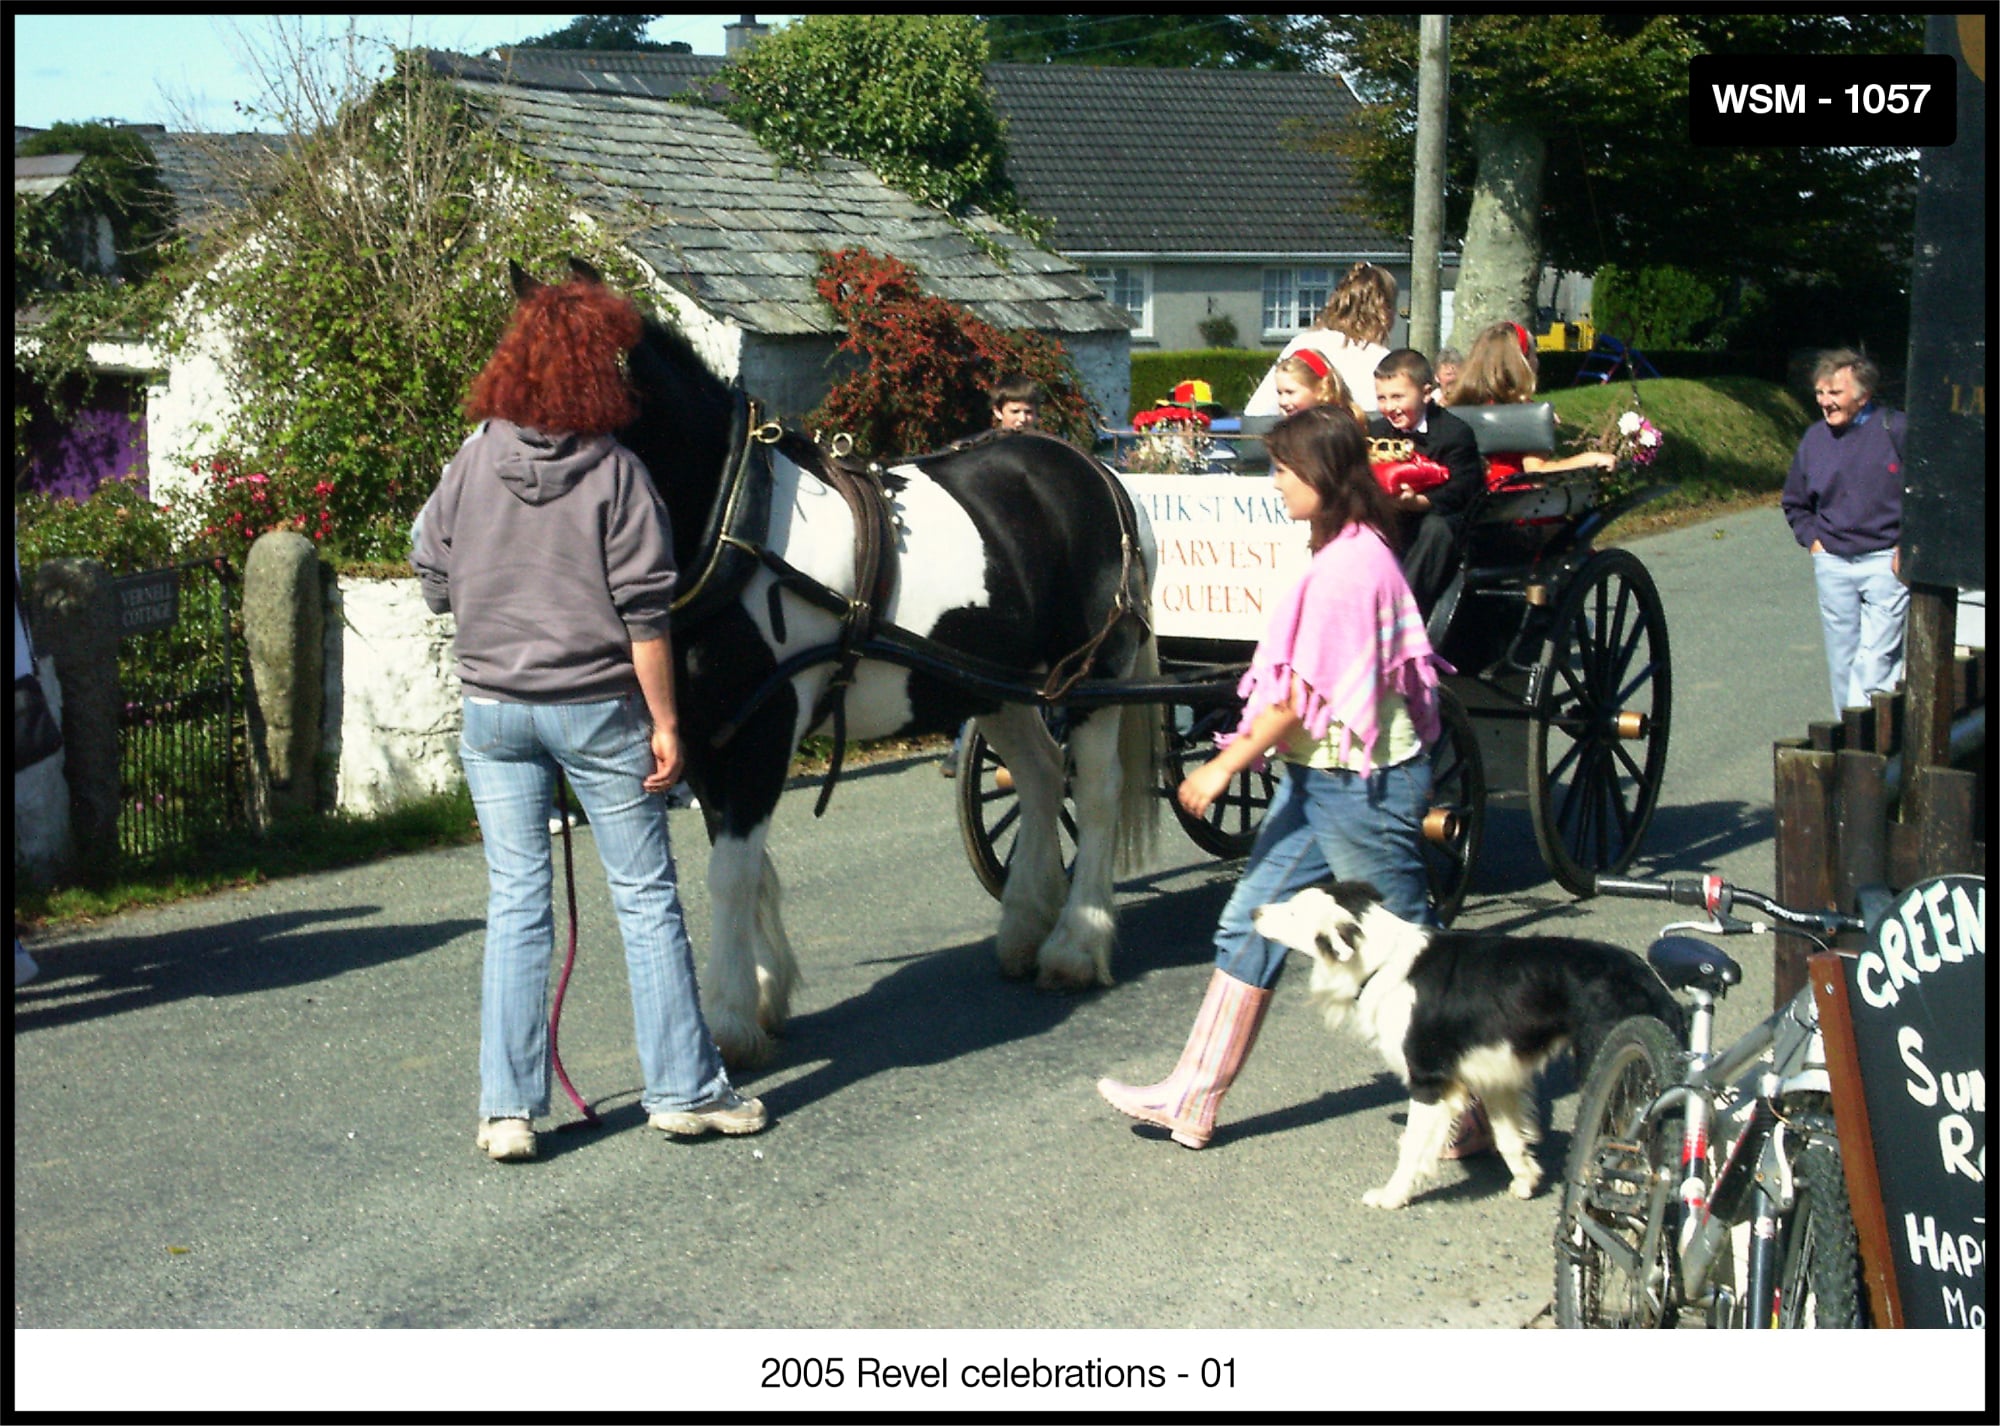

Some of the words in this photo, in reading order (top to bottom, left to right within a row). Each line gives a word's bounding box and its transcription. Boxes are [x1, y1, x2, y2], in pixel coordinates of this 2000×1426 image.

[1231, 495, 1296, 525] MAR
[122, 601, 172, 627] COTTAGE
[1163, 583, 1262, 614] QUEEN
[1857, 880, 1985, 1008] GREEN
[1939, 1114, 1985, 1183] R
[1905, 1212, 1985, 1278] HAP
